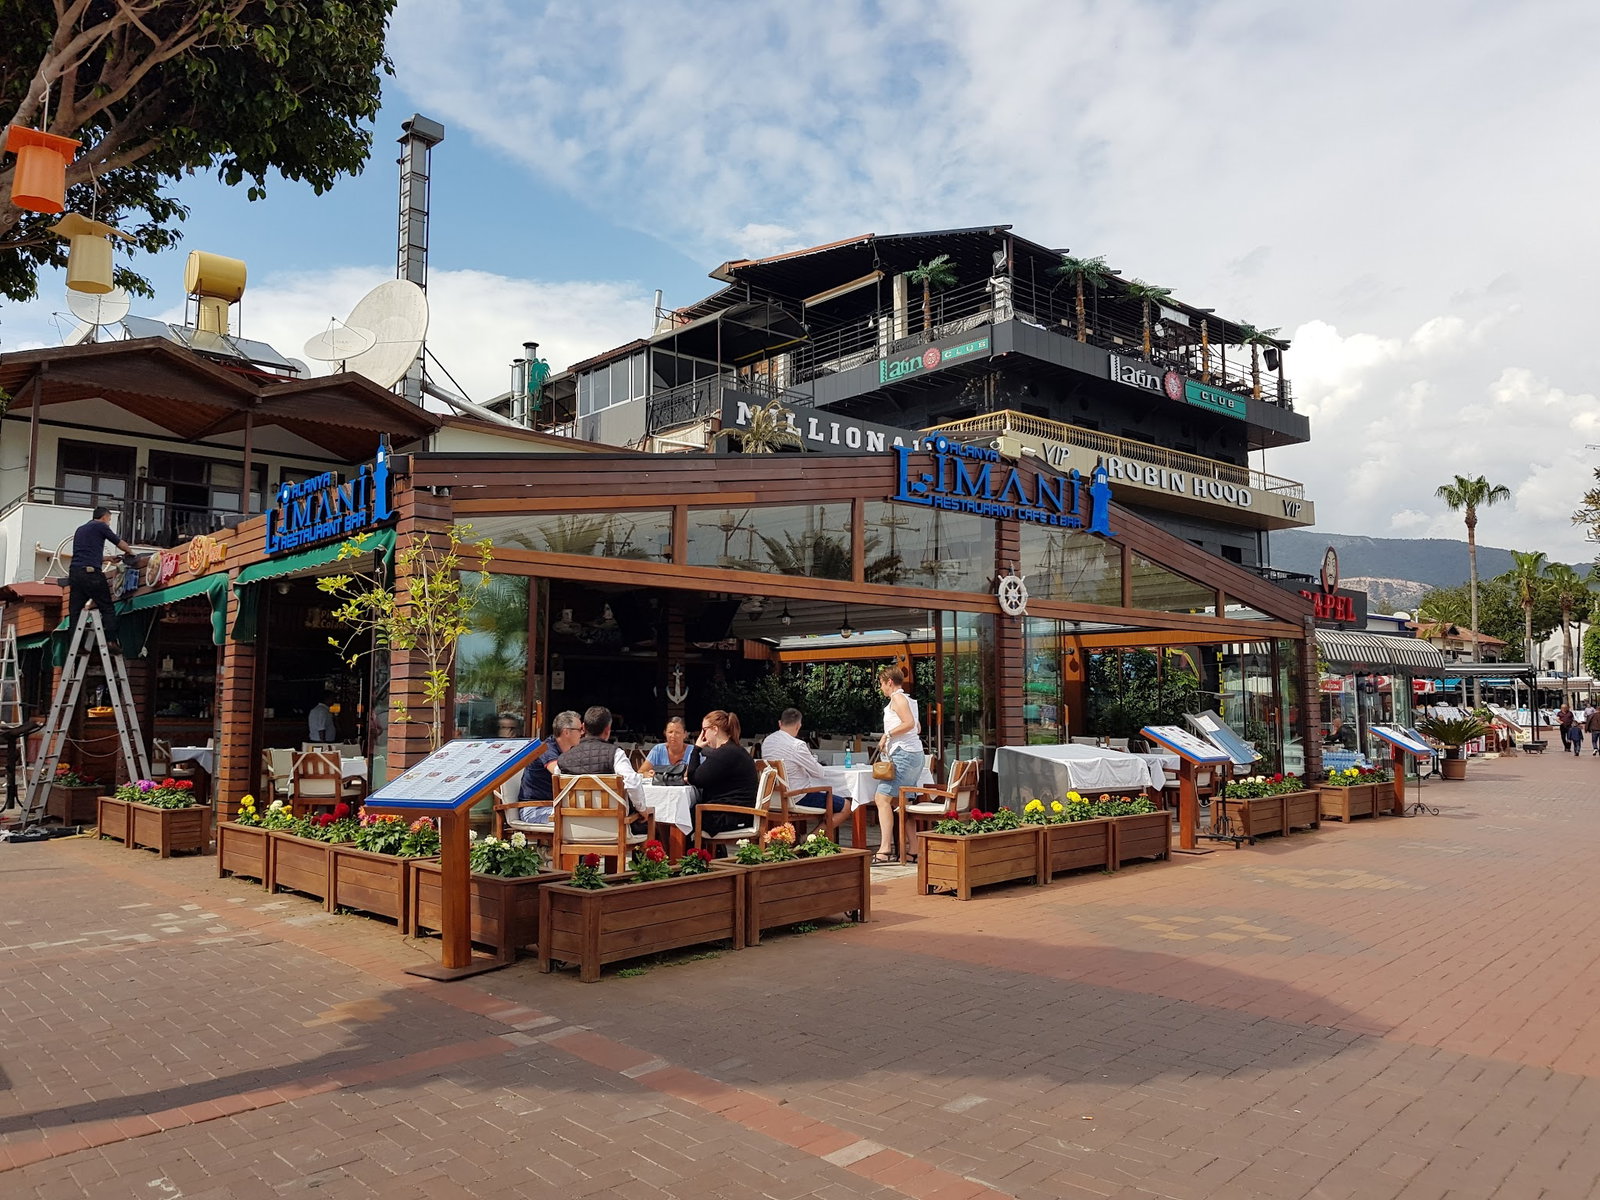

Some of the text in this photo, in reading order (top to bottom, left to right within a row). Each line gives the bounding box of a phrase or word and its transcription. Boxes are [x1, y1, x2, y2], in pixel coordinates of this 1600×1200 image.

[880, 341, 986, 383] Latin CLUB
[1110, 354, 1236, 408] Latin CLUB
[949, 443, 1000, 463] ALANYA
[292, 471, 331, 498] ALANYA
[1042, 442, 1302, 518] VIP ROBIN HOOD VIP
[280, 511, 367, 550] RESTAURANT BAR
[934, 496, 1082, 529] RESTAURANT CAFE & BAR
